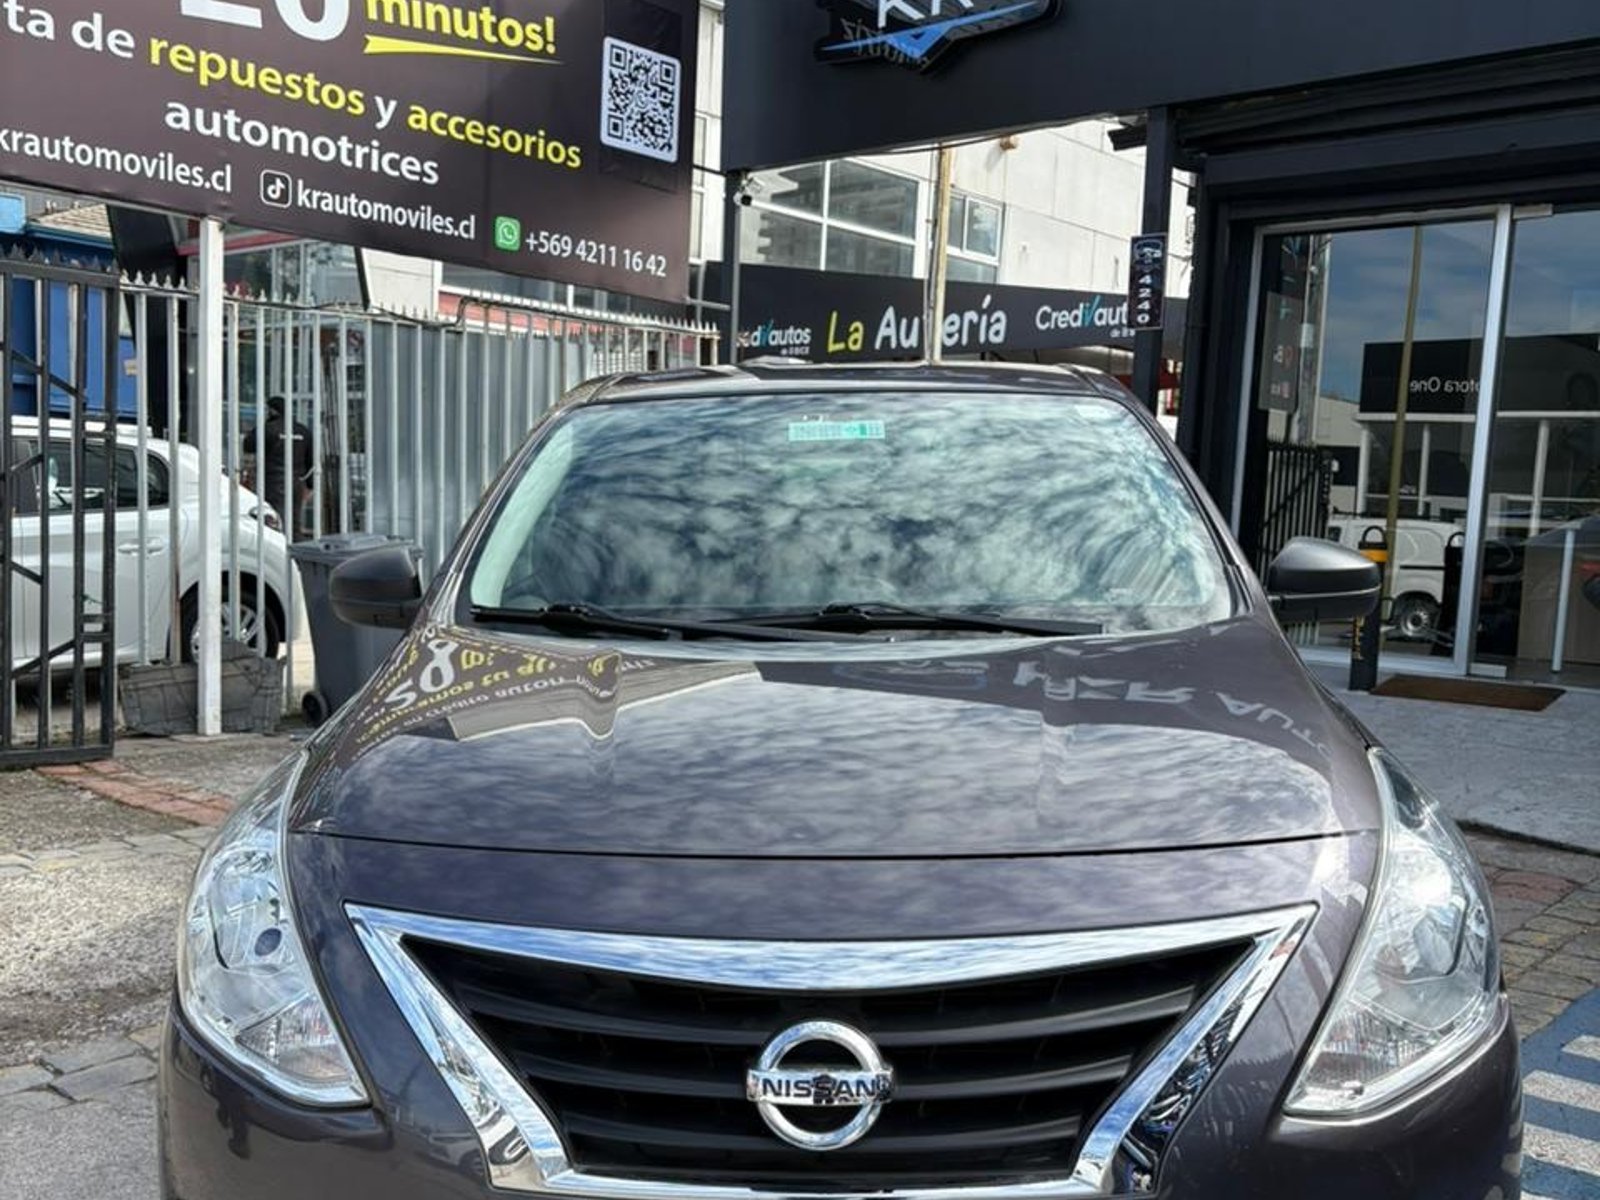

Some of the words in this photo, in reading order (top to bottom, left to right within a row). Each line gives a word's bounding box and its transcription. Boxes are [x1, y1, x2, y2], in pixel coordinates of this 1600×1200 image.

[71, 12, 136, 59] de
[149, 37, 366, 116] repuestos
[374, 94, 398, 130] y
[406, 104, 583, 169] accesorios
[164, 101, 440, 185] automotrices
[297, 179, 476, 240] krautomoviles.cl
[525, 231, 573, 258] +569
[575, 239, 617, 267] 4211
[827, 310, 865, 353] La
[874, 294, 1008, 351] Auería
[761, 1077, 876, 1099] NISSAN
